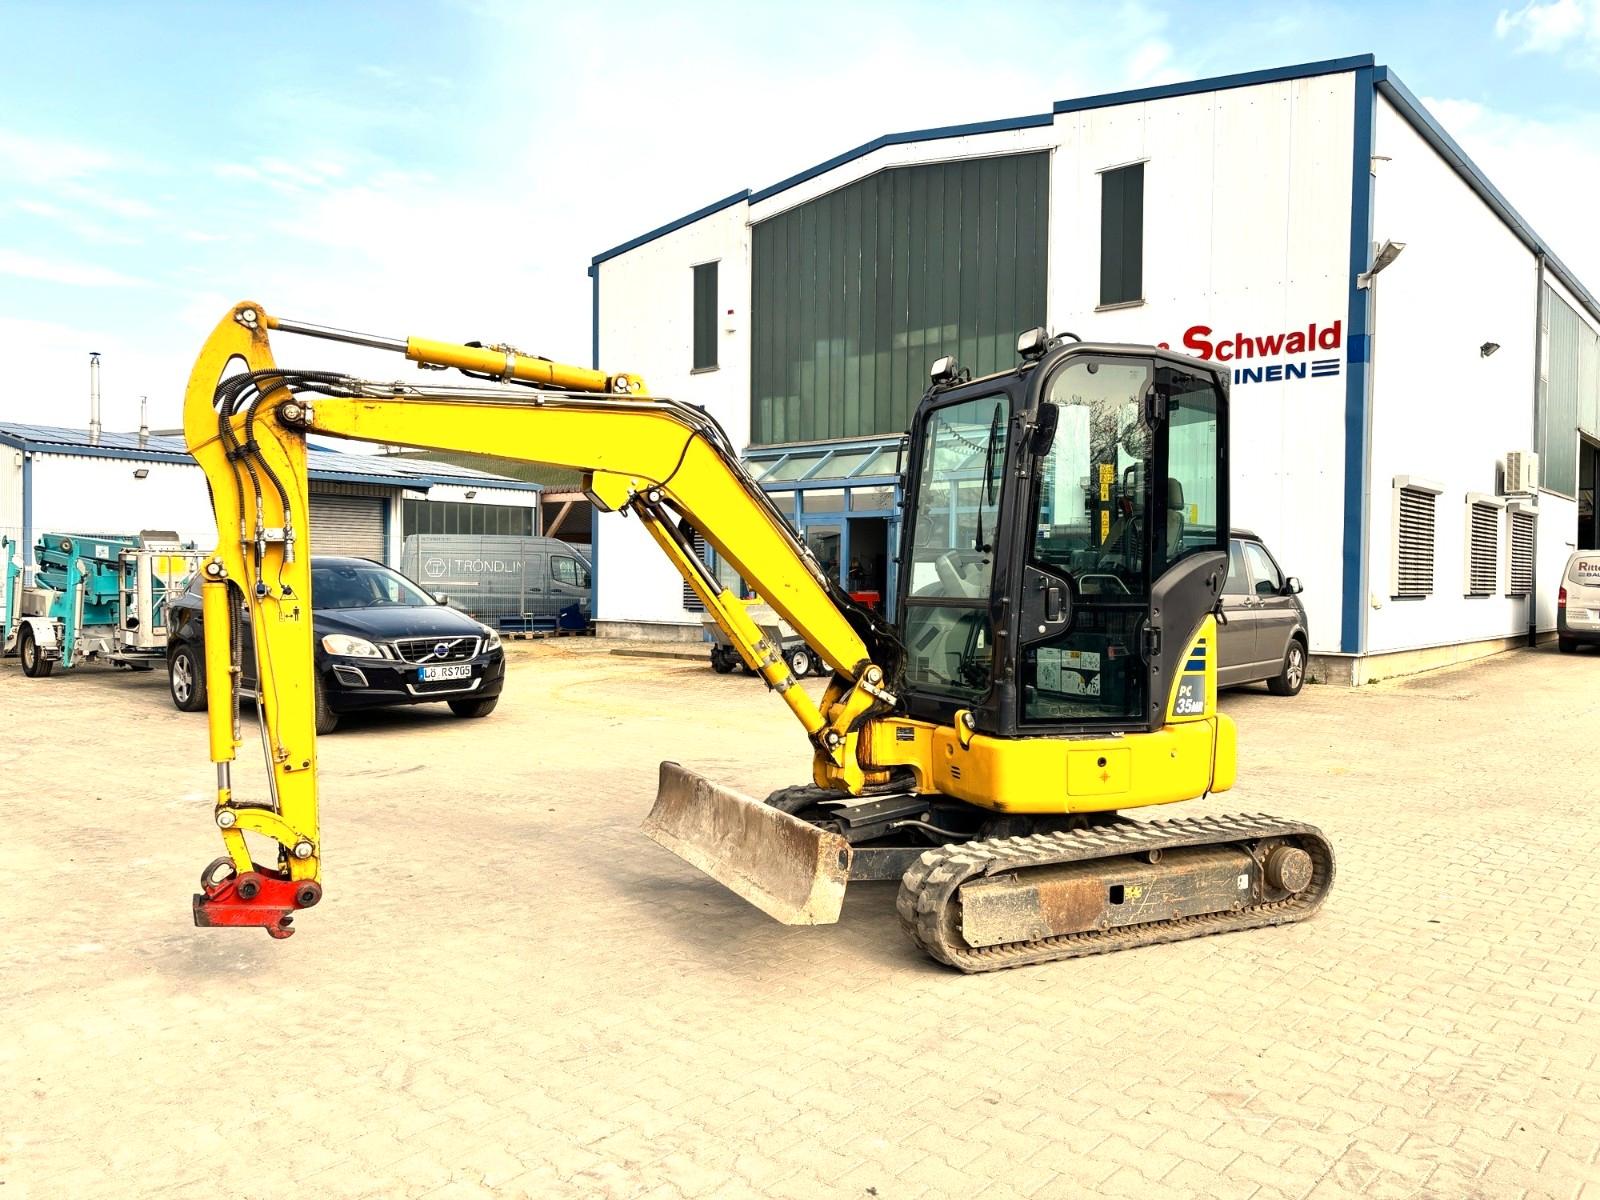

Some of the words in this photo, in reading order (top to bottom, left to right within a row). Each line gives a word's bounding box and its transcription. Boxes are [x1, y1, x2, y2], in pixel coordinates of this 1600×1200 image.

[1183, 320, 1341, 361] Schwald
[1234, 362, 1307, 385] INEN
[1179, 685, 1193, 697] PC
